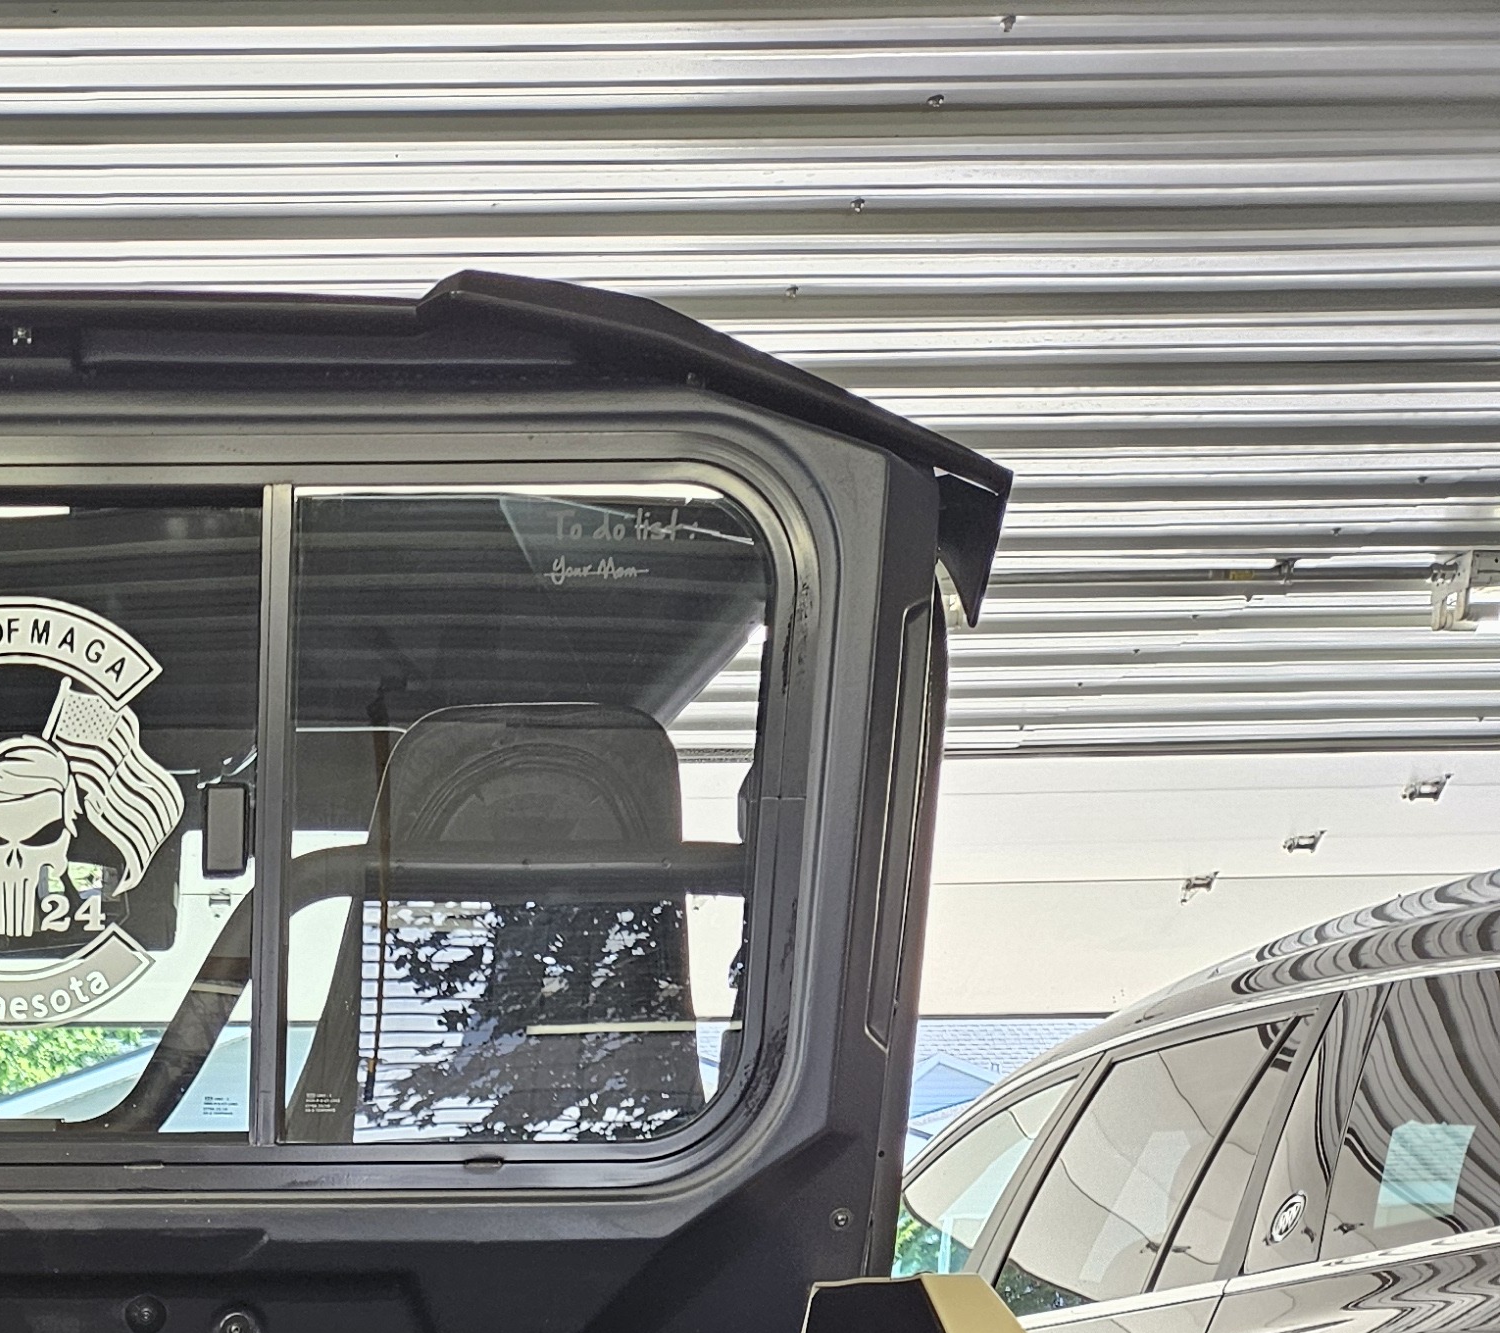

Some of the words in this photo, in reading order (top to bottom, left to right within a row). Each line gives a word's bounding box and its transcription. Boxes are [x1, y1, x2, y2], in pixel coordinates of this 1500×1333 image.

[547, 508, 583, 541] To
[592, 511, 626, 542] do
[40, 893, 107, 933] 24
